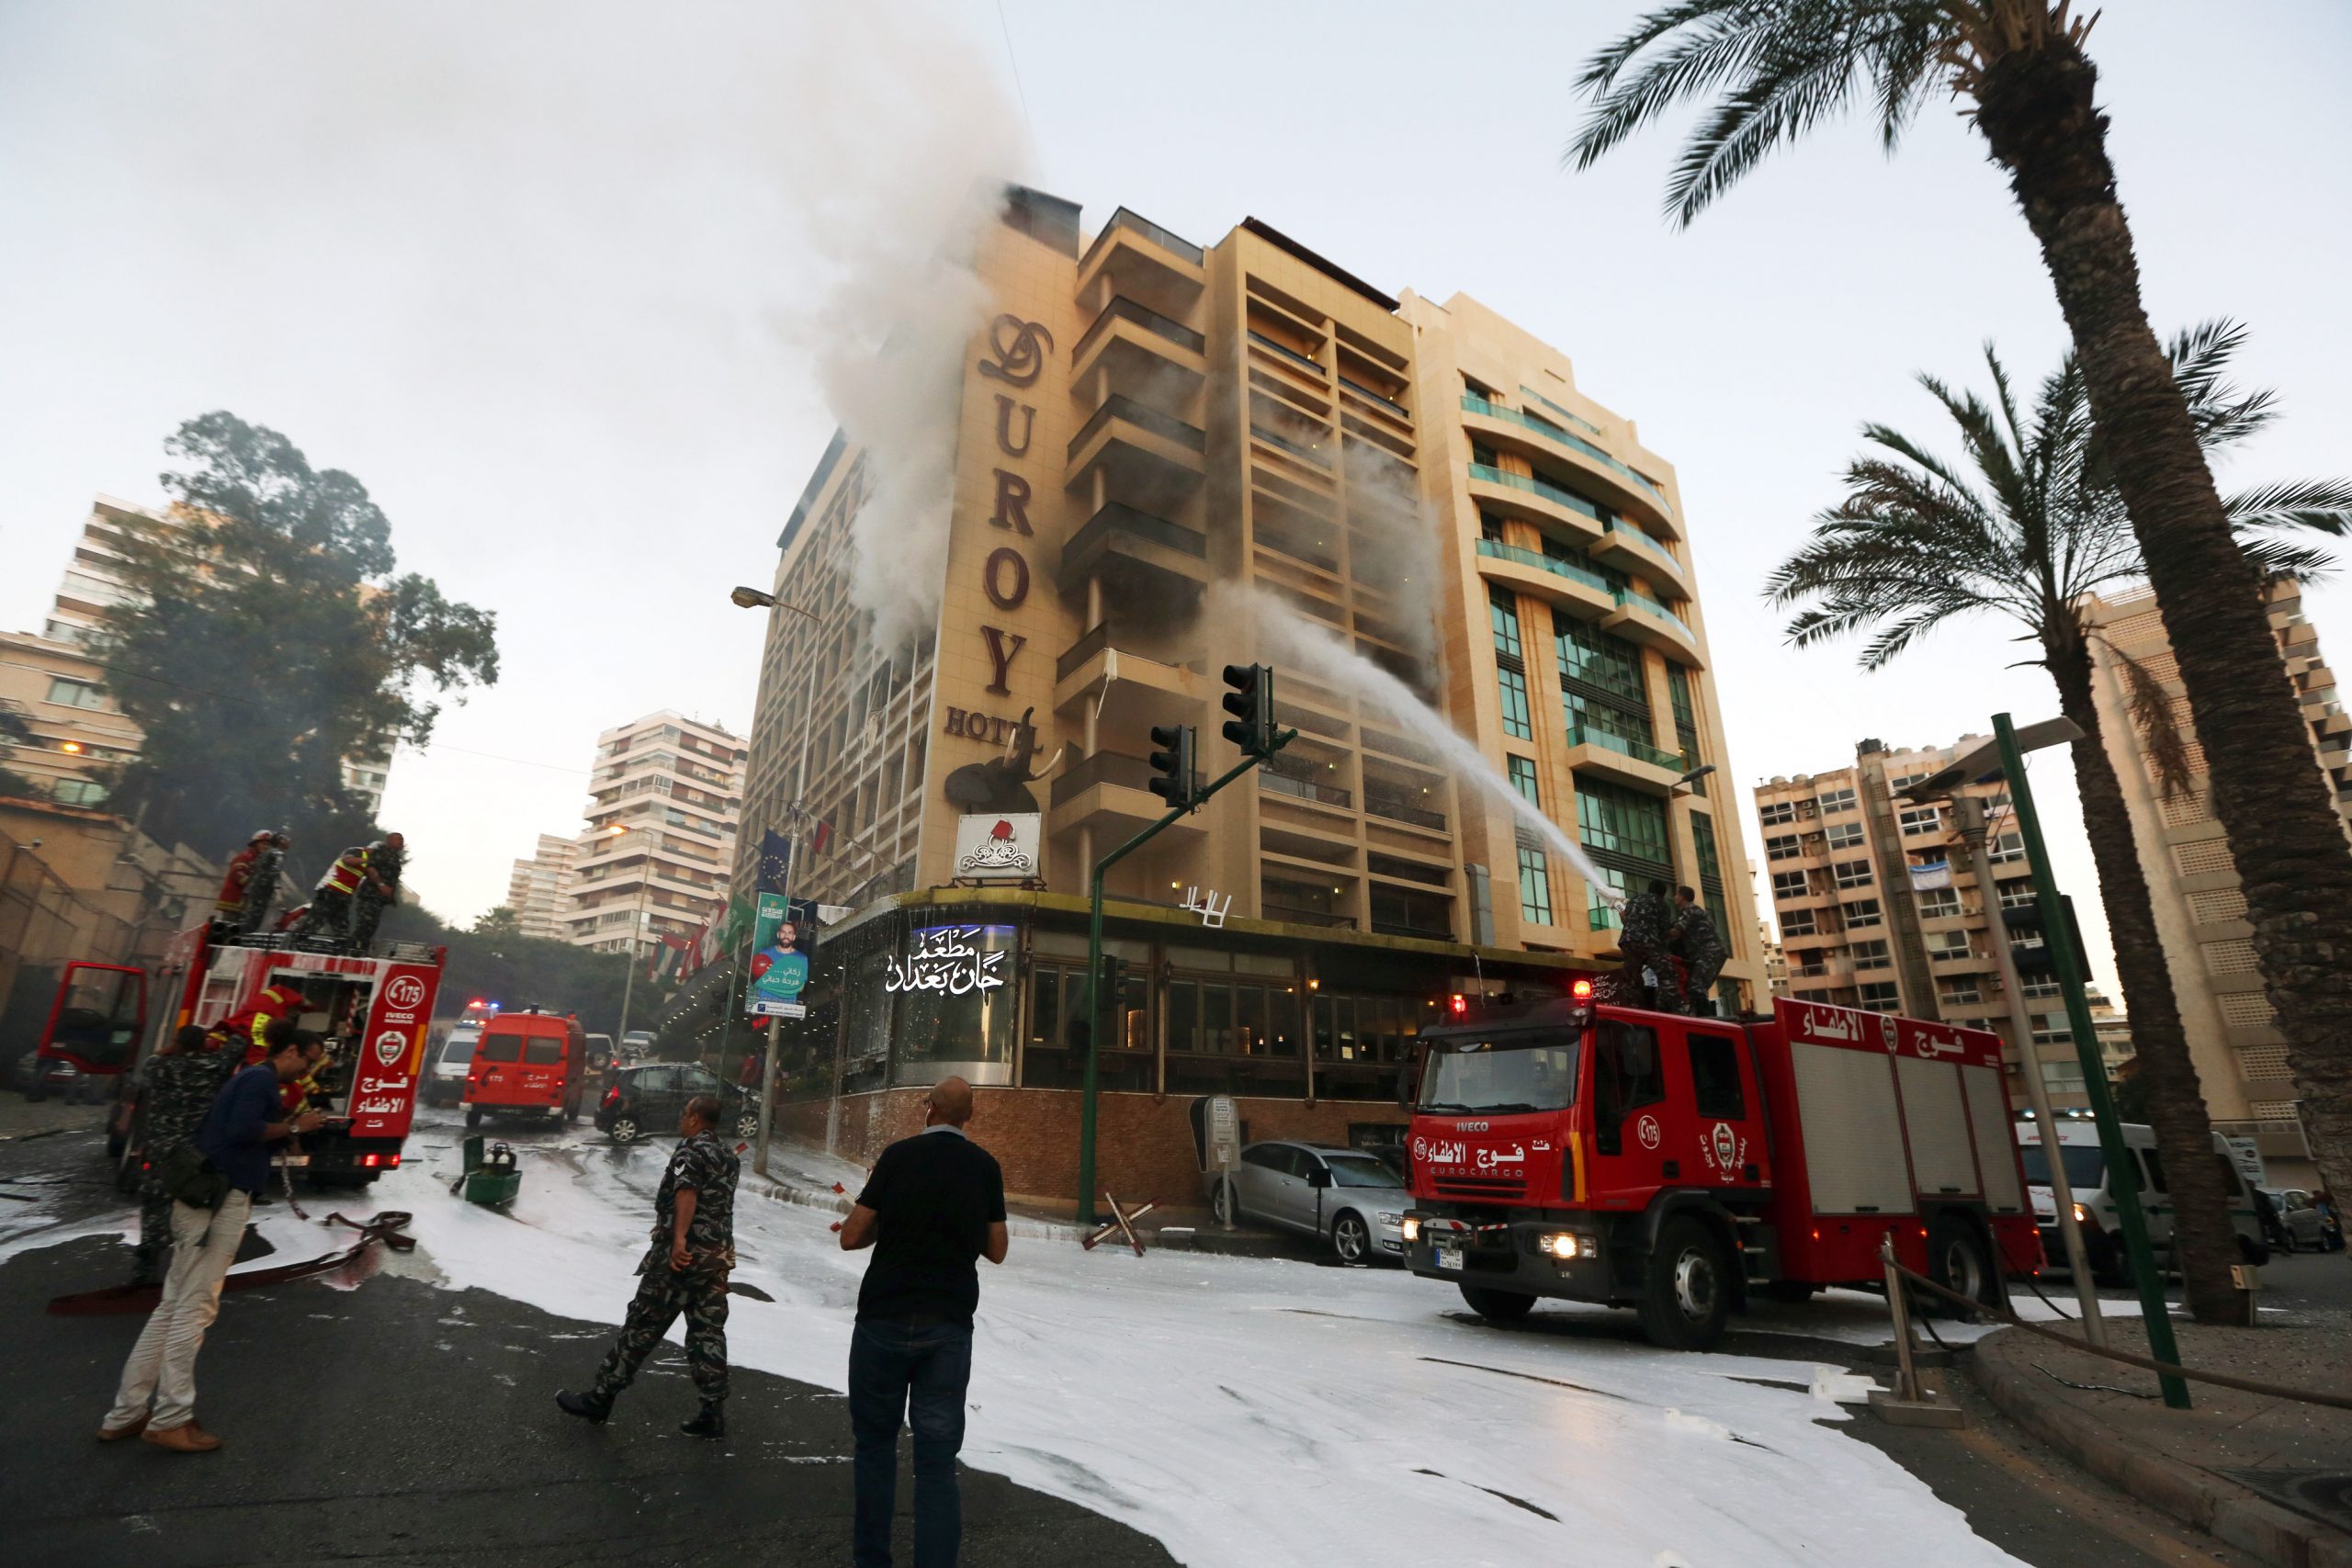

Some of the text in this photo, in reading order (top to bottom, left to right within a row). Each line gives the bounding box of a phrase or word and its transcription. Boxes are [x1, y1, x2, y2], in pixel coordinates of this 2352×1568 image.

[400, 986, 421, 1003] 175
[1914, 1027, 1965, 1058] فوج
[361, 1072, 409, 1093] فوج
[1456, 1122, 1489, 1133] IVECO
[1645, 1124, 1658, 1142] 175
[1476, 1143, 1525, 1168] فوج
[1430, 1167, 1524, 1177] EUROCARGO
